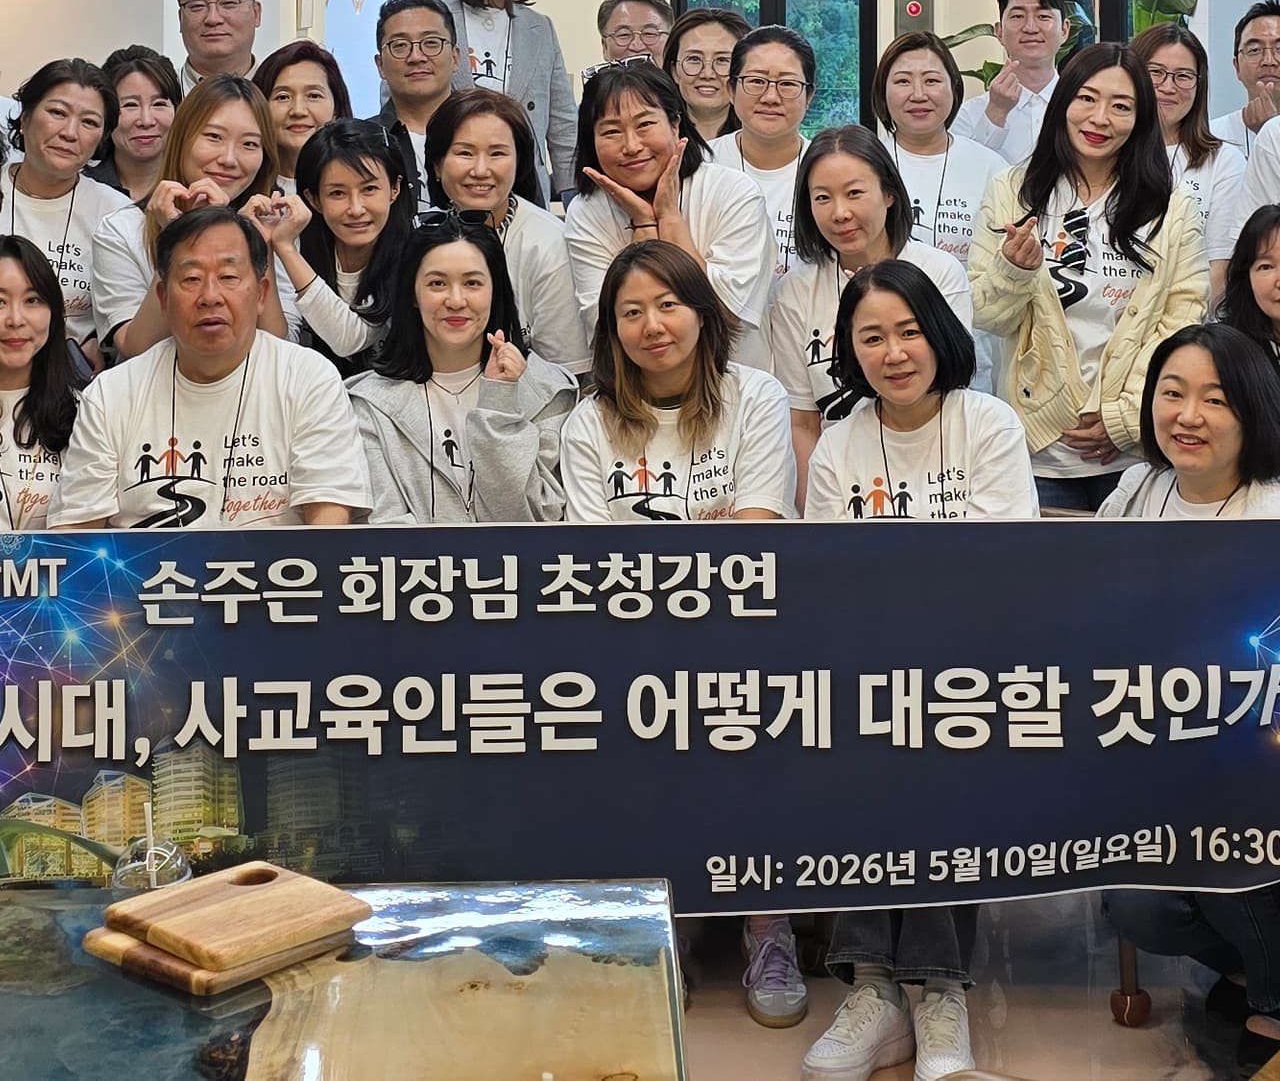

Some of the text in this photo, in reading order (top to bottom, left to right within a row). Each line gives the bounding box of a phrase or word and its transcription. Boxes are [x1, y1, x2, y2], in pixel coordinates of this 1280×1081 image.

[937, 211, 971, 222] make
[937, 223, 973, 237] the ro
[48, 240, 82, 257] Let's
[1102, 265, 1127, 277] the
[223, 433, 260, 449] Let's
[18, 451, 58, 465] make
[223, 453, 265, 469] make
[222, 471, 288, 488] the road
[692, 465, 729, 484] make
[927, 466, 966, 485] Let's
[693, 481, 734, 502] the ro
[138, 551, 778, 626] 손주은 회장님 초청강연
[173, 670, 604, 760] 사교육인들은
[626, 668, 831, 752] 어떻게
[858, 664, 1070, 750] 대응할
[705, 853, 784, 893] 일시:
[795, 849, 917, 887] 2026년
[928, 823, 1178, 883] 5월10일(일요일)
